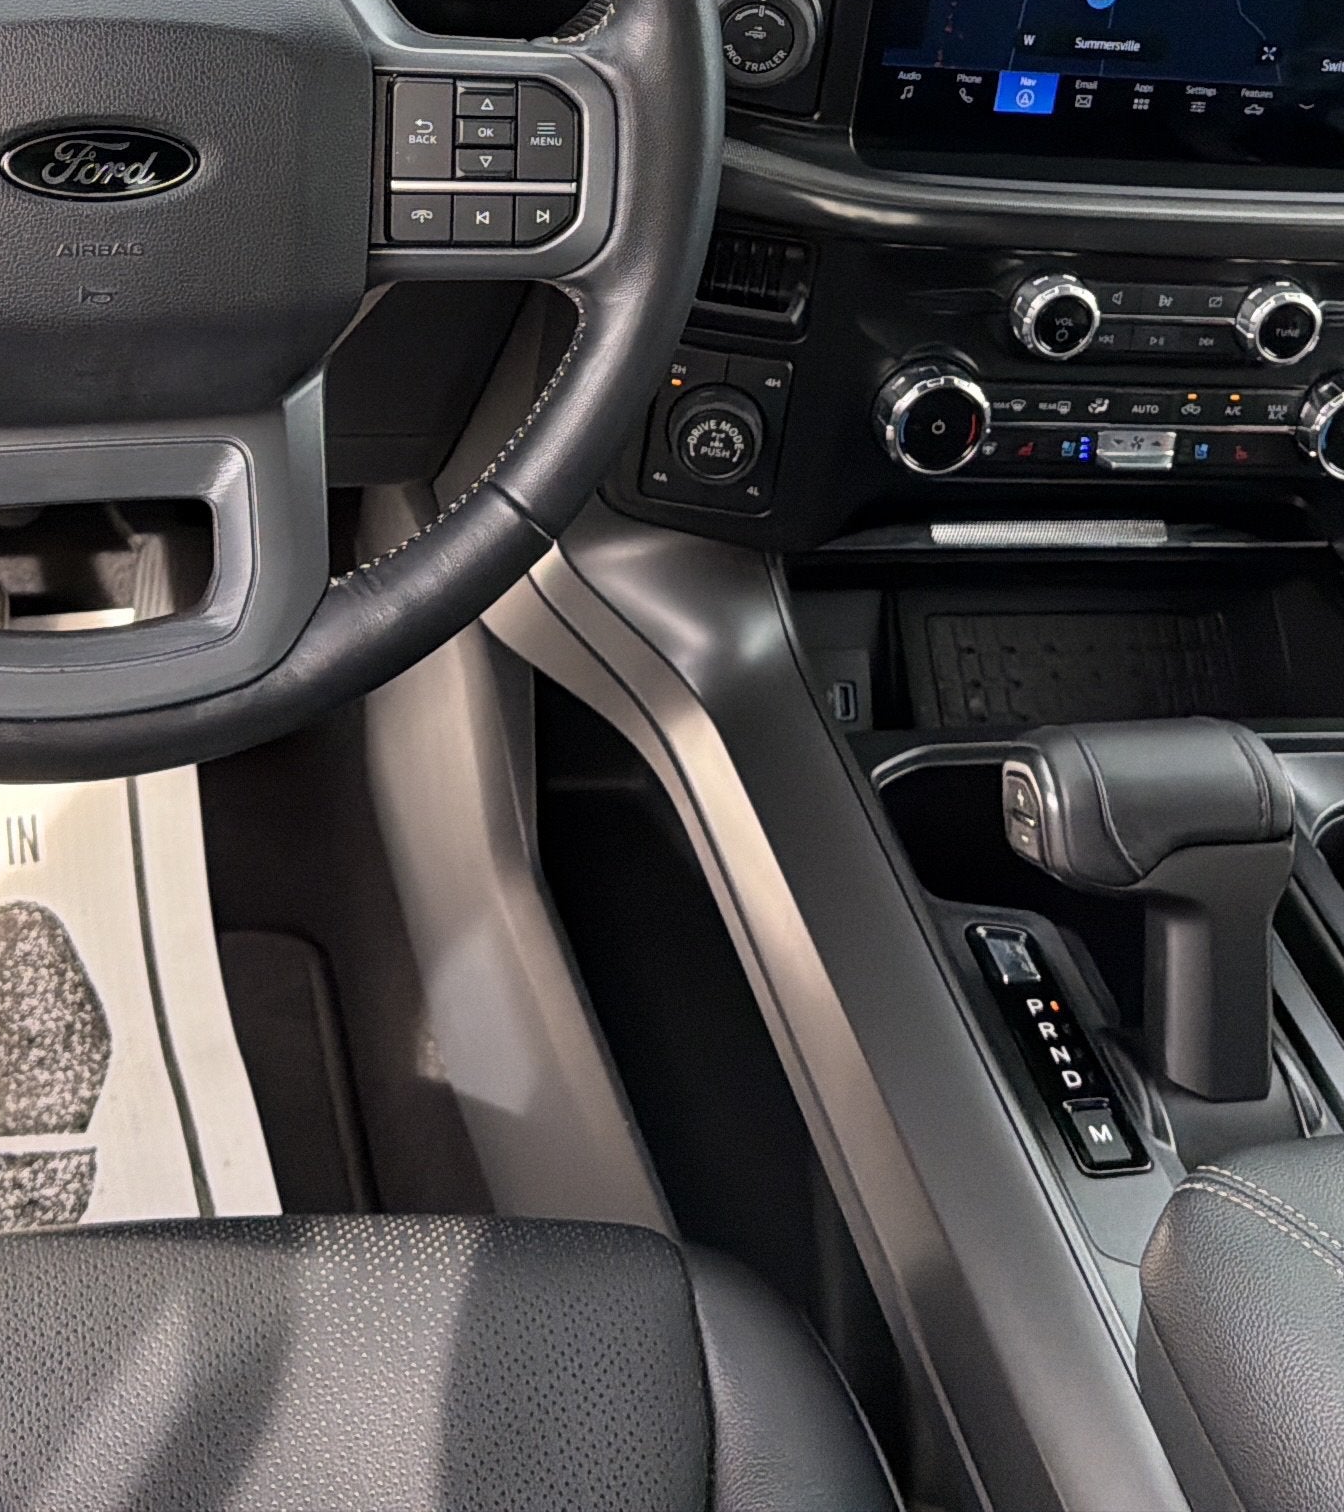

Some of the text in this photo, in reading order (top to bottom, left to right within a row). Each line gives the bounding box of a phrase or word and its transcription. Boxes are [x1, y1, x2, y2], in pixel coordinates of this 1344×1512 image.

[1024, 35, 1036, 46] W
[1075, 37, 1141, 52] Summersville
[723, 43, 788, 72] PRO TRAILER
[898, 71, 922, 81] Audio
[956, 74, 982, 84] Phone
[1020, 76, 1036, 87] Nav
[1075, 80, 1098, 90] Email
[1134, 83, 1154, 94] Apps
[1186, 85, 1217, 97] Settings
[1241, 88, 1273, 99] Features
[478, 128, 494, 137] OK
[409, 135, 437, 144] BACK
[530, 137, 562, 146] MENU
[41, 139, 162, 188] Ford
[56, 242, 144, 257] AIRBAG
[1055, 318, 1074, 326] VOL
[1276, 329, 1300, 337] TUNE
[765, 378, 782, 388] 4H
[1131, 404, 1159, 414] AUTO
[1225, 405, 1242, 416] A/C
[688, 419, 745, 450] DRIVE MODE
[700, 446, 731, 459] PUSH
[6, 814, 41, 866] IN
[1026, 999, 1044, 1017] P
[1038, 1021, 1059, 1040] R
[1049, 1046, 1072, 1064] N
[1061, 1070, 1083, 1088] D
[1088, 1124, 1113, 1143] M
